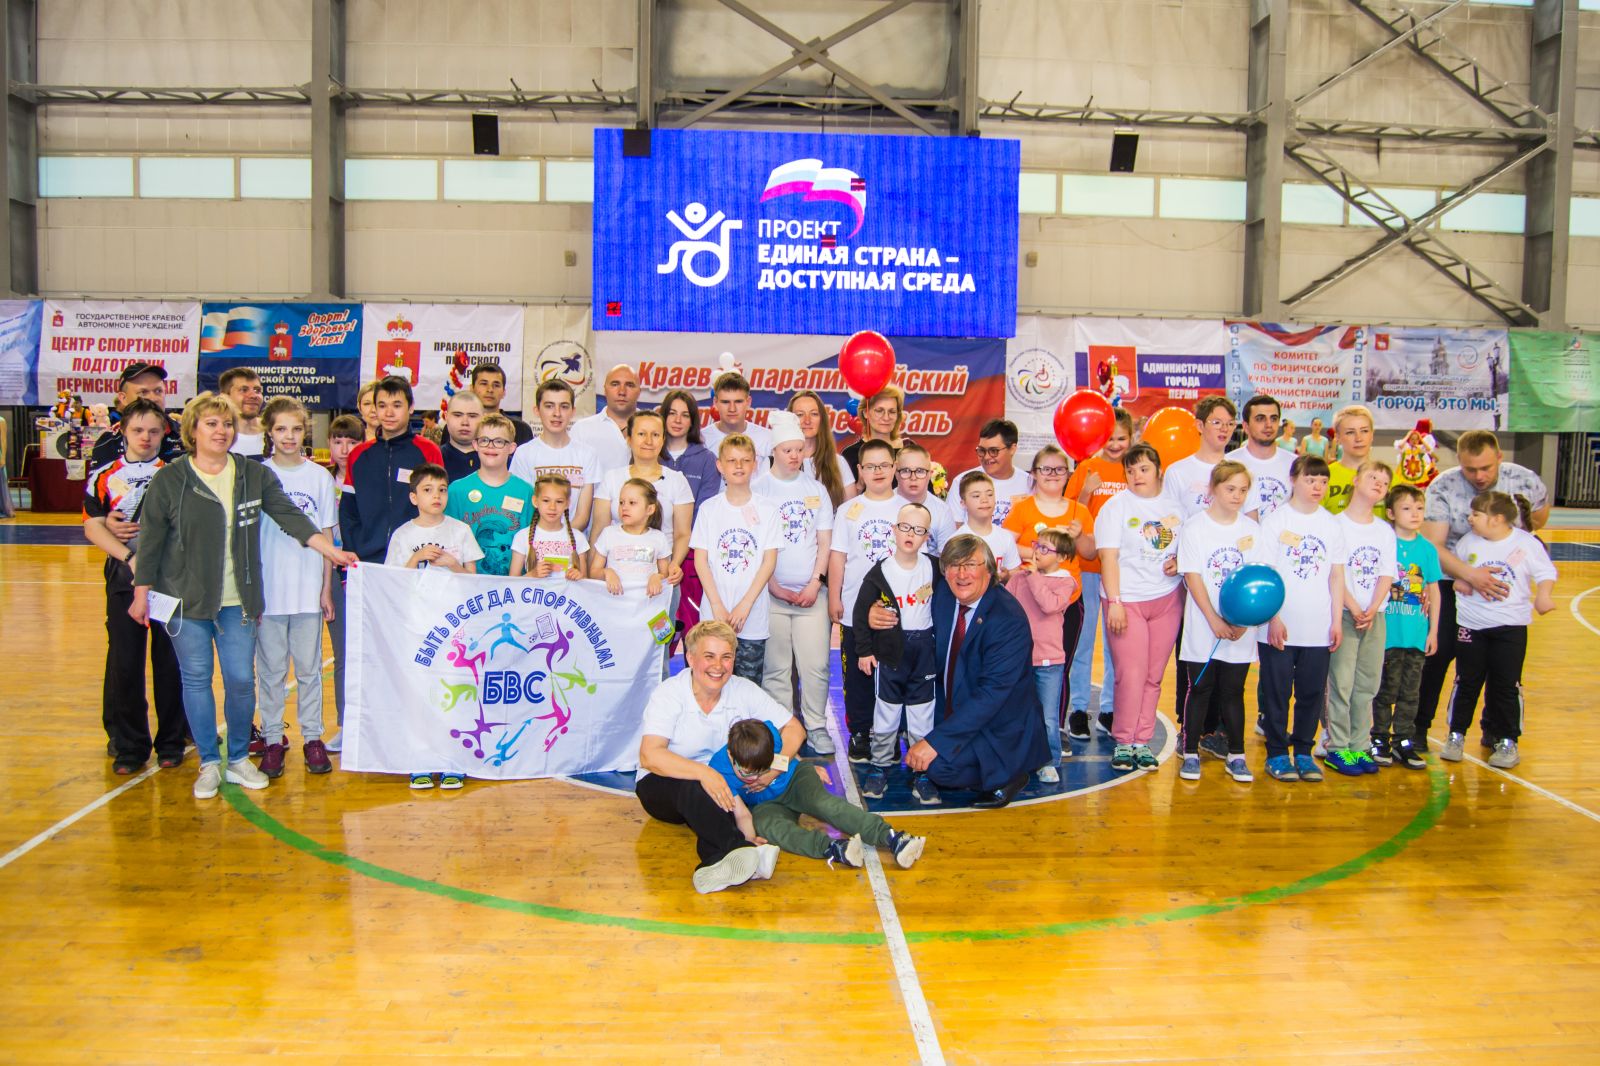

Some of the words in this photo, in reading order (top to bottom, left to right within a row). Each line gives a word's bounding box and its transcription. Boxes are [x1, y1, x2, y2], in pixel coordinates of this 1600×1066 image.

[758, 219, 841, 239] ПРОЕКТ
[758, 243, 849, 266] ЕДИНАЯ
[855, 246, 941, 267] СТРАНА
[757, 269, 896, 291] ДОСТУПНАЯ
[902, 272, 976, 293] СРЕДА
[76, 313, 150, 321] ГОСУДАРСТВЕННОЕ
[152, 314, 187, 322] КРАЕВОЕ
[308, 309, 350, 325] Спорт!
[132, 322, 183, 330] УЧРЕЖДЕНИЕ
[299, 319, 357, 337] Здоровье!
[51, 336, 95, 352] ЦЕНТР
[98, 336, 189, 353] СПОРТИВНОЙ
[309, 333, 346, 347] Успех!
[433, 342, 511, 352] ПРАВИТЕЛЬСТВО
[1274, 351, 1319, 360] КОМИТЕТ
[1142, 362, 1221, 375] АДМИНИСТРАЦИЯ
[1253, 363, 1268, 371] ПО
[1271, 363, 1339, 373] ФИЗИЧЕСКОЙ
[288, 375, 335, 384] КУЛЬТУРЫ
[1164, 376, 1200, 387] ГОРОДА
[1248, 374, 1293, 384] КУЛЬТУРЕ
[1297, 376, 1305, 385] И
[1308, 377, 1346, 386] СПОРТУ
[57, 378, 120, 394] ПЕРМСКО
[266, 385, 301, 393] СПОРТА
[1168, 388, 1199, 400] ПЕРМИ
[1254, 388, 1340, 398] АДМИНИСТРАЦИИ
[1299, 401, 1333, 410] ПЕРМИ
[1438, 398, 1467, 410] ЭТО
[414, 624, 450, 668] БЫТЬ
[445, 587, 516, 629] ВСЕГДА
[520, 587, 616, 670] СПОРТИВНЫМ!
[482, 670, 547, 704] БВС
